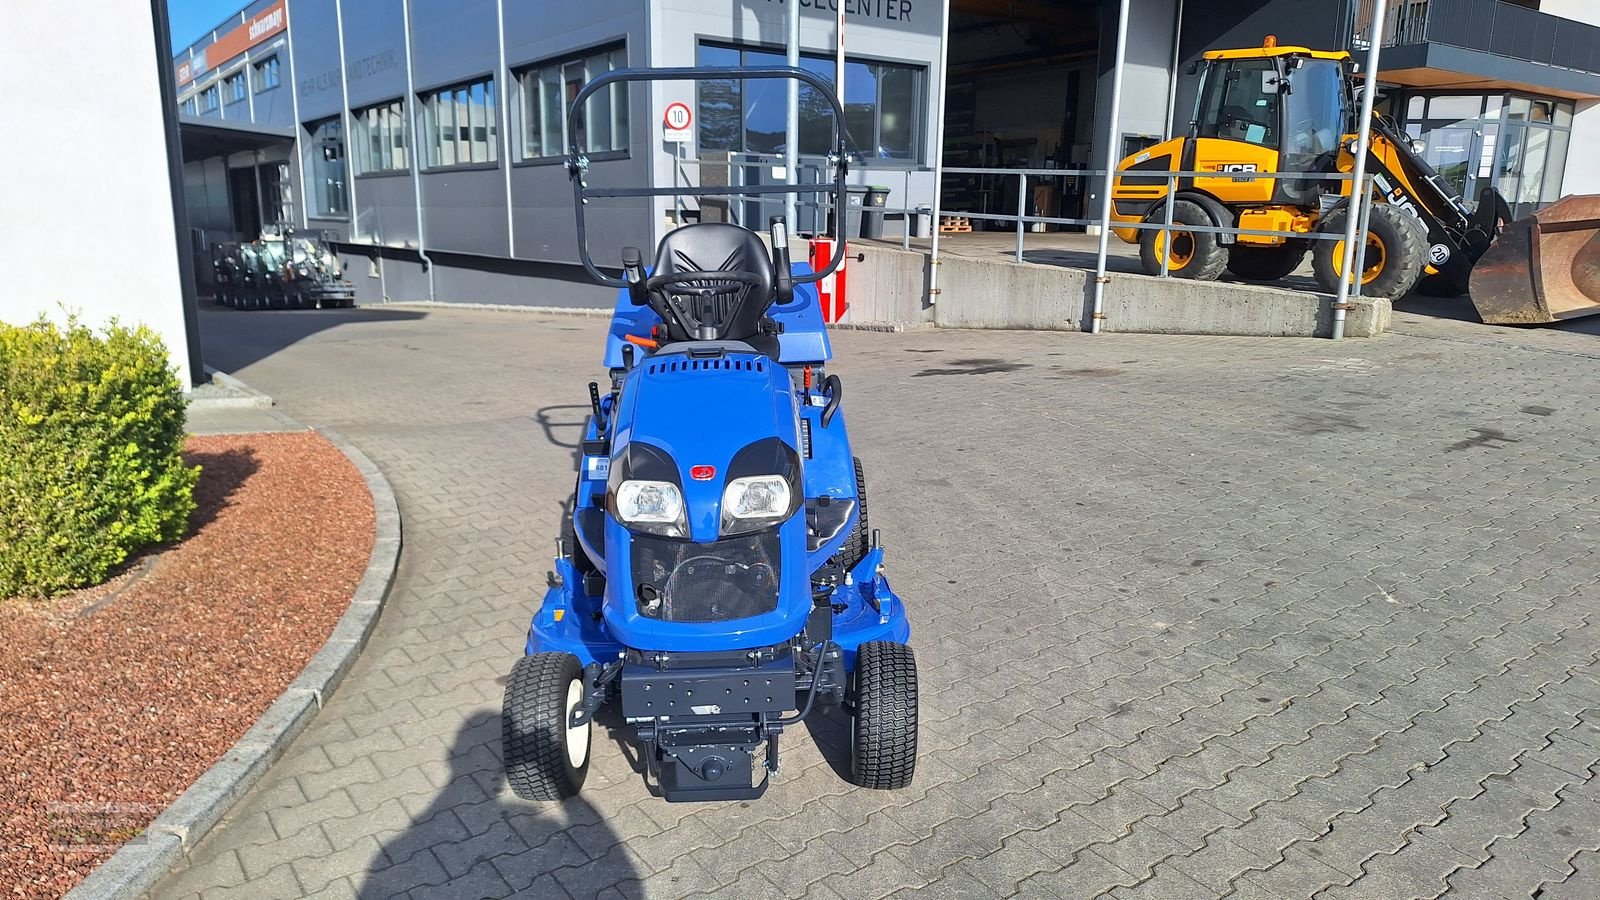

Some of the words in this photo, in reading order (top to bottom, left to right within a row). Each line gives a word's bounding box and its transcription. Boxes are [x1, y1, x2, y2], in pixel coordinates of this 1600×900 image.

[673, 110, 683, 123] 10
[1387, 192, 1430, 233] JC
[1432, 247, 1446, 261] 20
